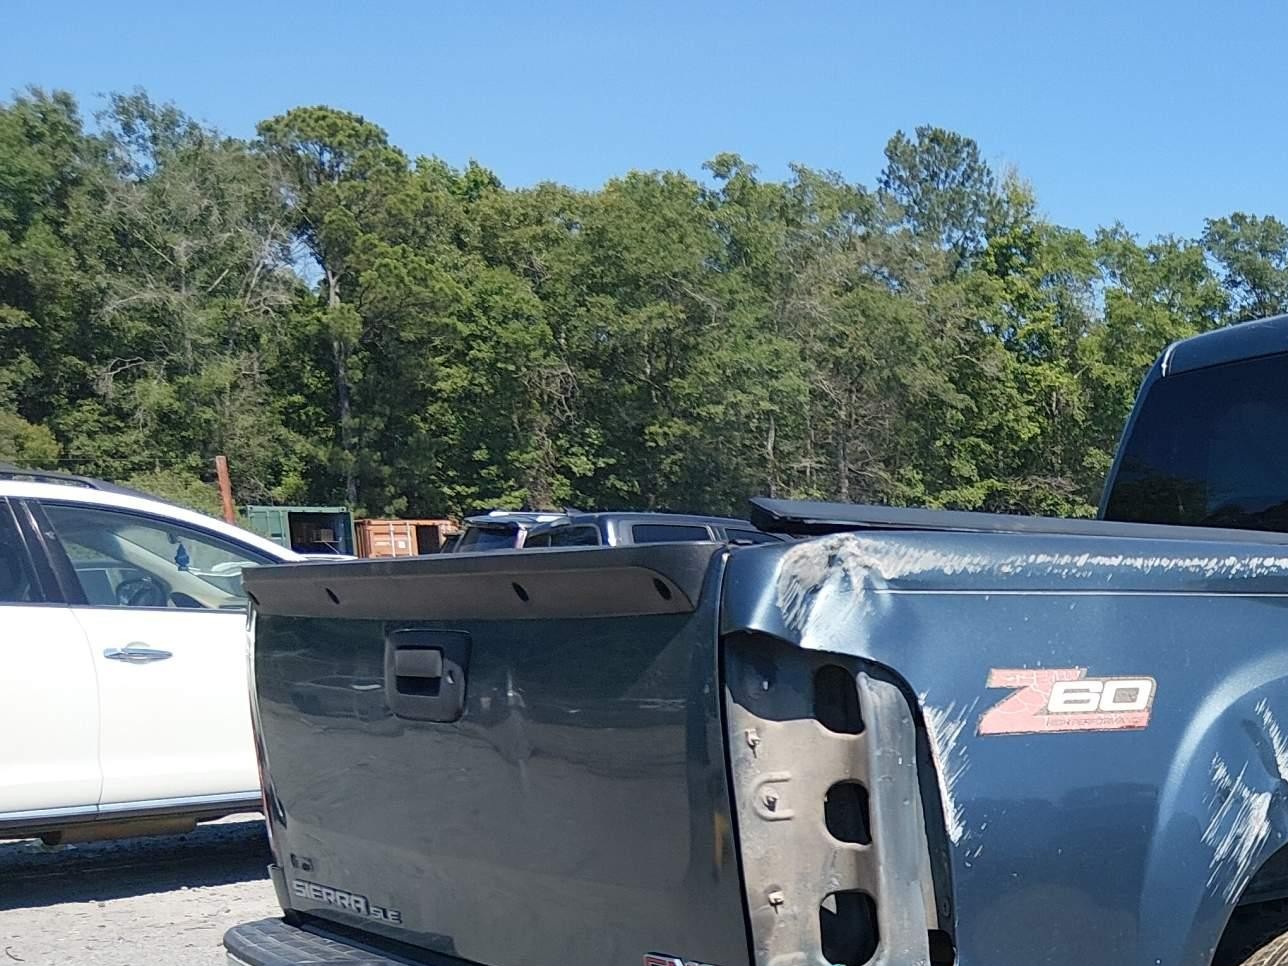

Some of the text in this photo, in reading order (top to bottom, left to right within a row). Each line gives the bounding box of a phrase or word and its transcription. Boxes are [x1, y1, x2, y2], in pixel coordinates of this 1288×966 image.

[975, 668, 1157, 737] Z60
[292, 879, 402, 924] SIERRA SLE
